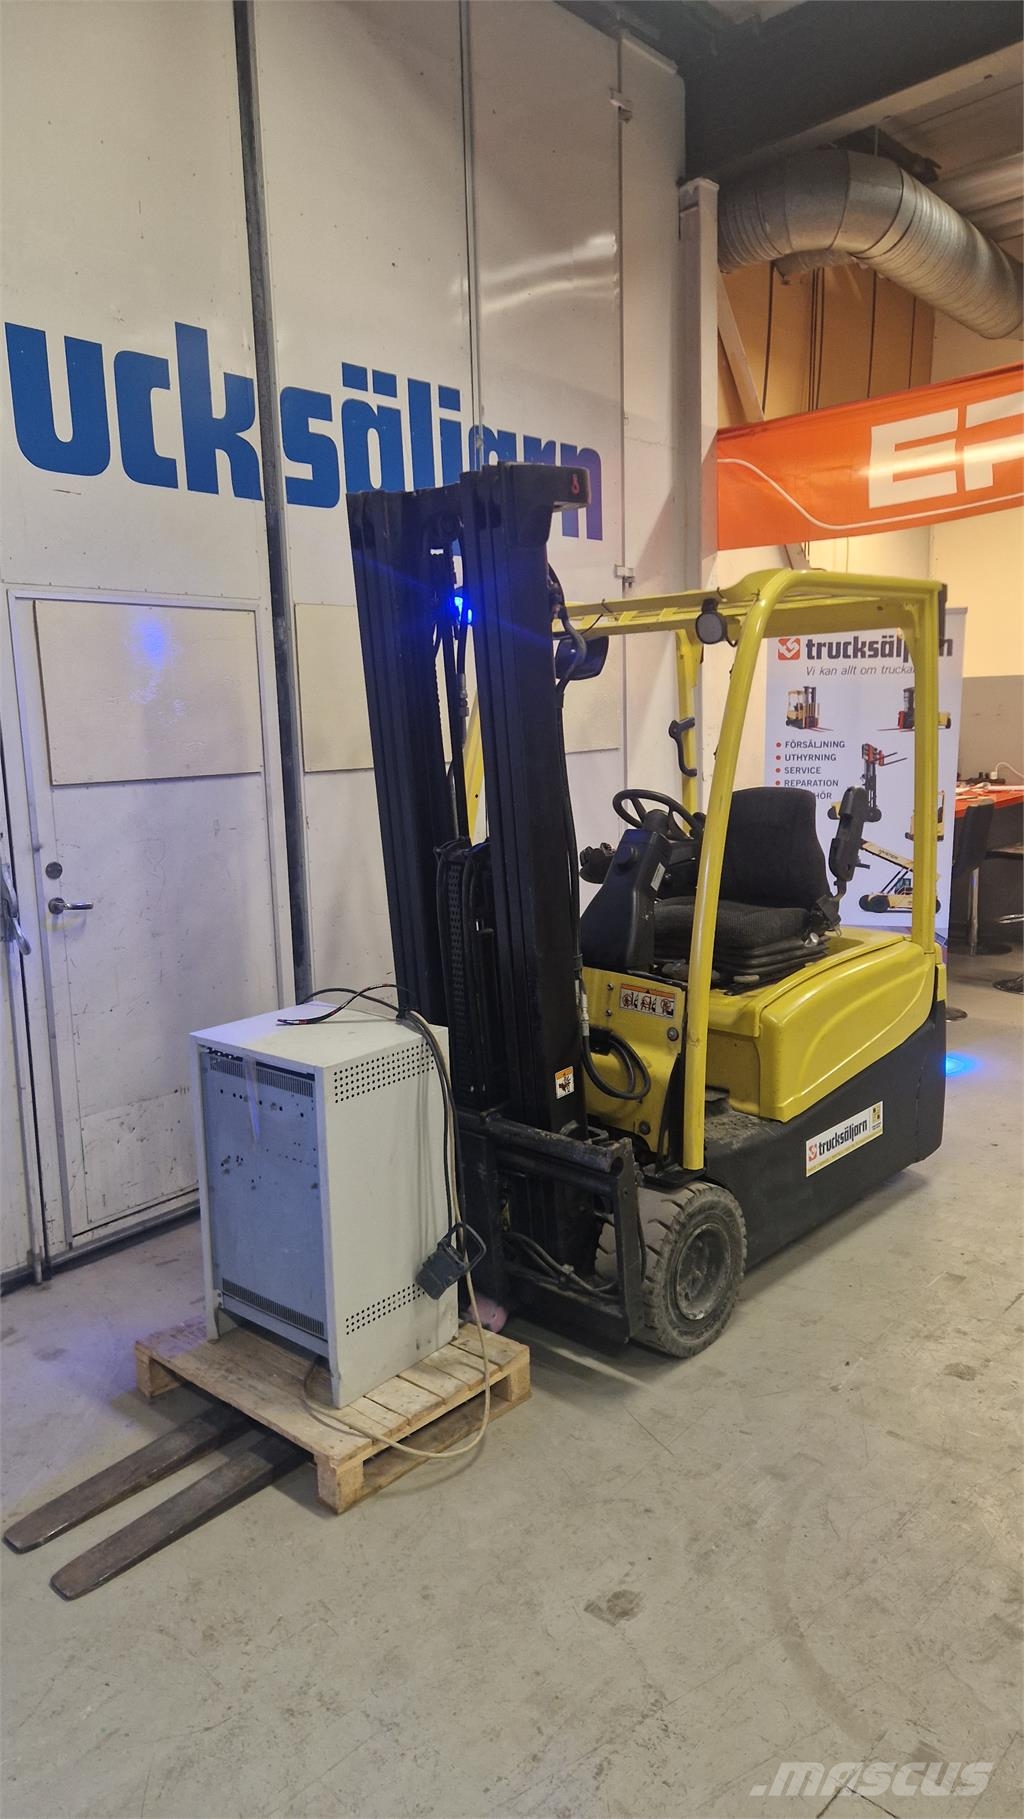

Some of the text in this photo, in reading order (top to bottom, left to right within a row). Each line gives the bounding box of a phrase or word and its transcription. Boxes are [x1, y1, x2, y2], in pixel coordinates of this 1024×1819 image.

[806, 664, 915, 676] Vi kan allt om trucka
[784, 753, 837, 762] UTHYRNING
[784, 766, 822, 775] SERVICE
[784, 779, 839, 787] REPARATION
